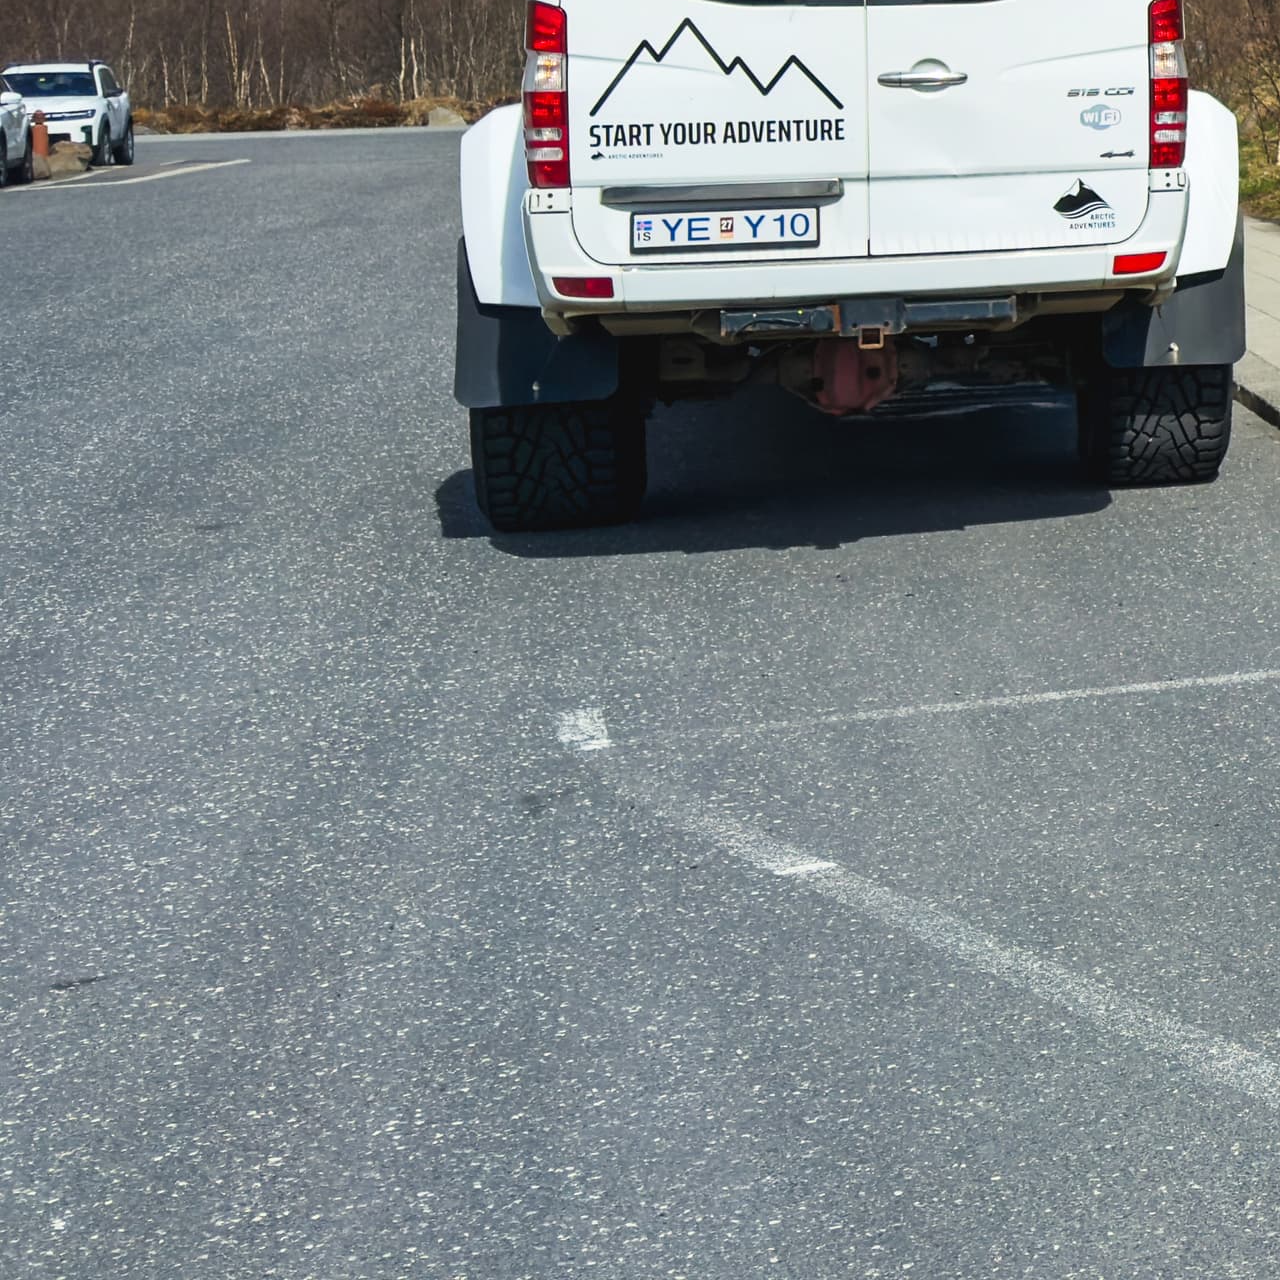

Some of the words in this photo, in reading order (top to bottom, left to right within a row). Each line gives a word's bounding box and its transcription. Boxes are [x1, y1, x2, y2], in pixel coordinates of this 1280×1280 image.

[589, 124, 654, 147] START
[660, 122, 716, 145] YOUR
[723, 119, 845, 143] ADVENTURE
[662, 217, 711, 242] YE
[744, 213, 810, 238] Y10
[720, 219, 733, 231] 27
[1069, 221, 1115, 230] ADVENTURES
[637, 232, 651, 241] IS
